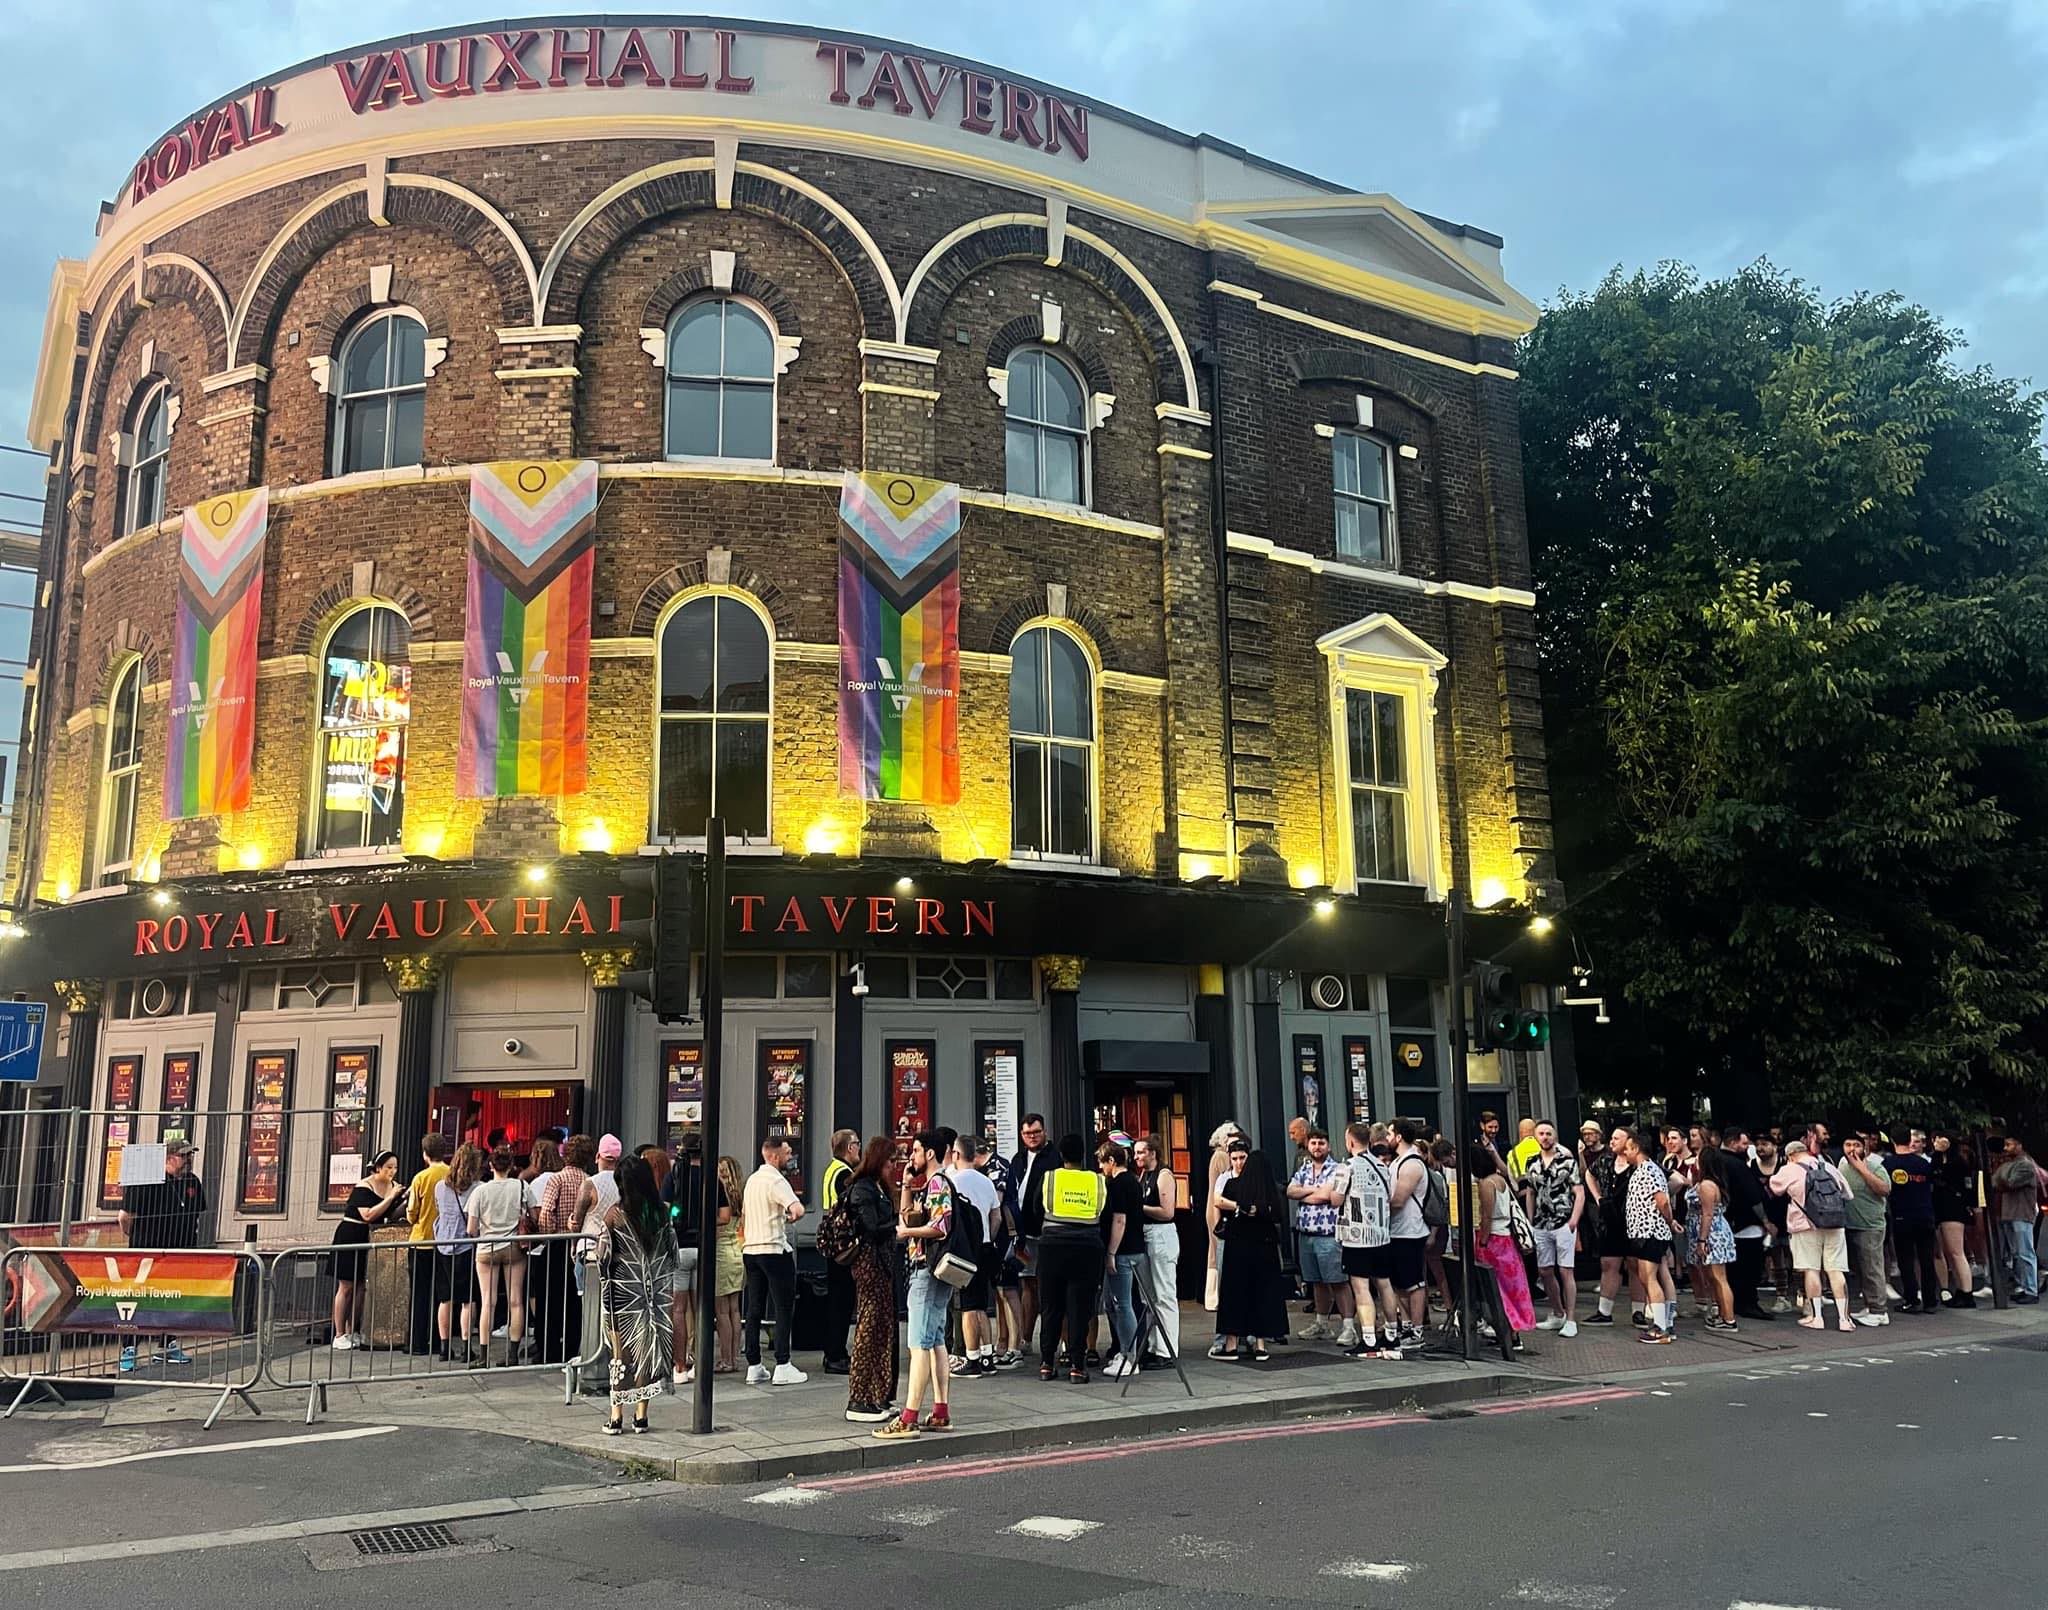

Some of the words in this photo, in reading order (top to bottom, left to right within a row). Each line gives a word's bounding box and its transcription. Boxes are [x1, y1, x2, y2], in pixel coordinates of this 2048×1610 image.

[132, 86, 283, 206] ROYAL
[333, 28, 755, 115] VAUXHALL
[816, 39, 1092, 162] TAVERN
[469, 676, 494, 689] Royal
[496, 674, 542, 685] Vauxhall
[544, 674, 579, 684] Tavern
[847, 681, 876, 692] Royal
[878, 681, 921, 695] Vauxhall
[922, 686, 953, 697] Tavern
[134, 909, 288, 956] ROYAL
[328, 895, 625, 941] VAUXHAL
[730, 895, 998, 937] TAVERN
[76, 1285, 104, 1299] Royal
[105, 1285, 146, 1298] Vauxhall
[149, 1287, 181, 1299] Tavern
